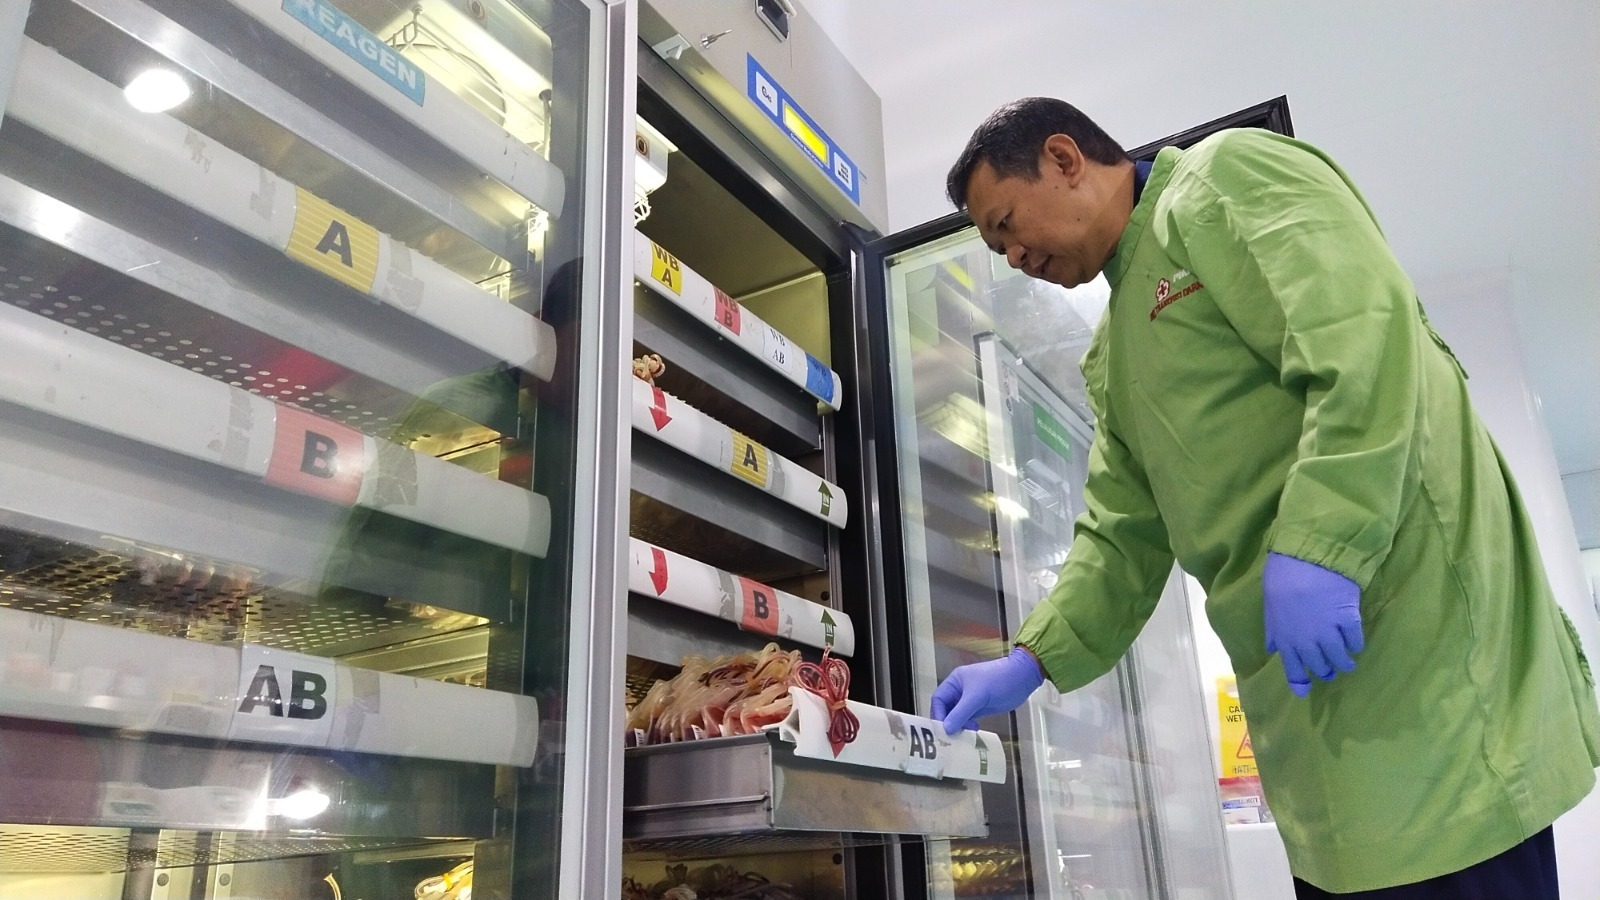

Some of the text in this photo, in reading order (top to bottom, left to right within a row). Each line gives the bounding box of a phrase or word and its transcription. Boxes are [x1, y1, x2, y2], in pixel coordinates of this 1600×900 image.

[315, 219, 353, 268] A
[653, 243, 680, 272] WB
[661, 267, 673, 288] A
[715, 288, 739, 314] WB
[723, 309, 733, 328] B
[770, 328, 786, 346] WB
[772, 349, 785, 365] AB
[301, 429, 338, 479] B
[742, 442, 759, 473] A
[752, 590, 770, 620] B
[237, 664, 327, 721] AB
[1225, 714, 1242, 723] WET
[909, 724, 937, 761] AB
